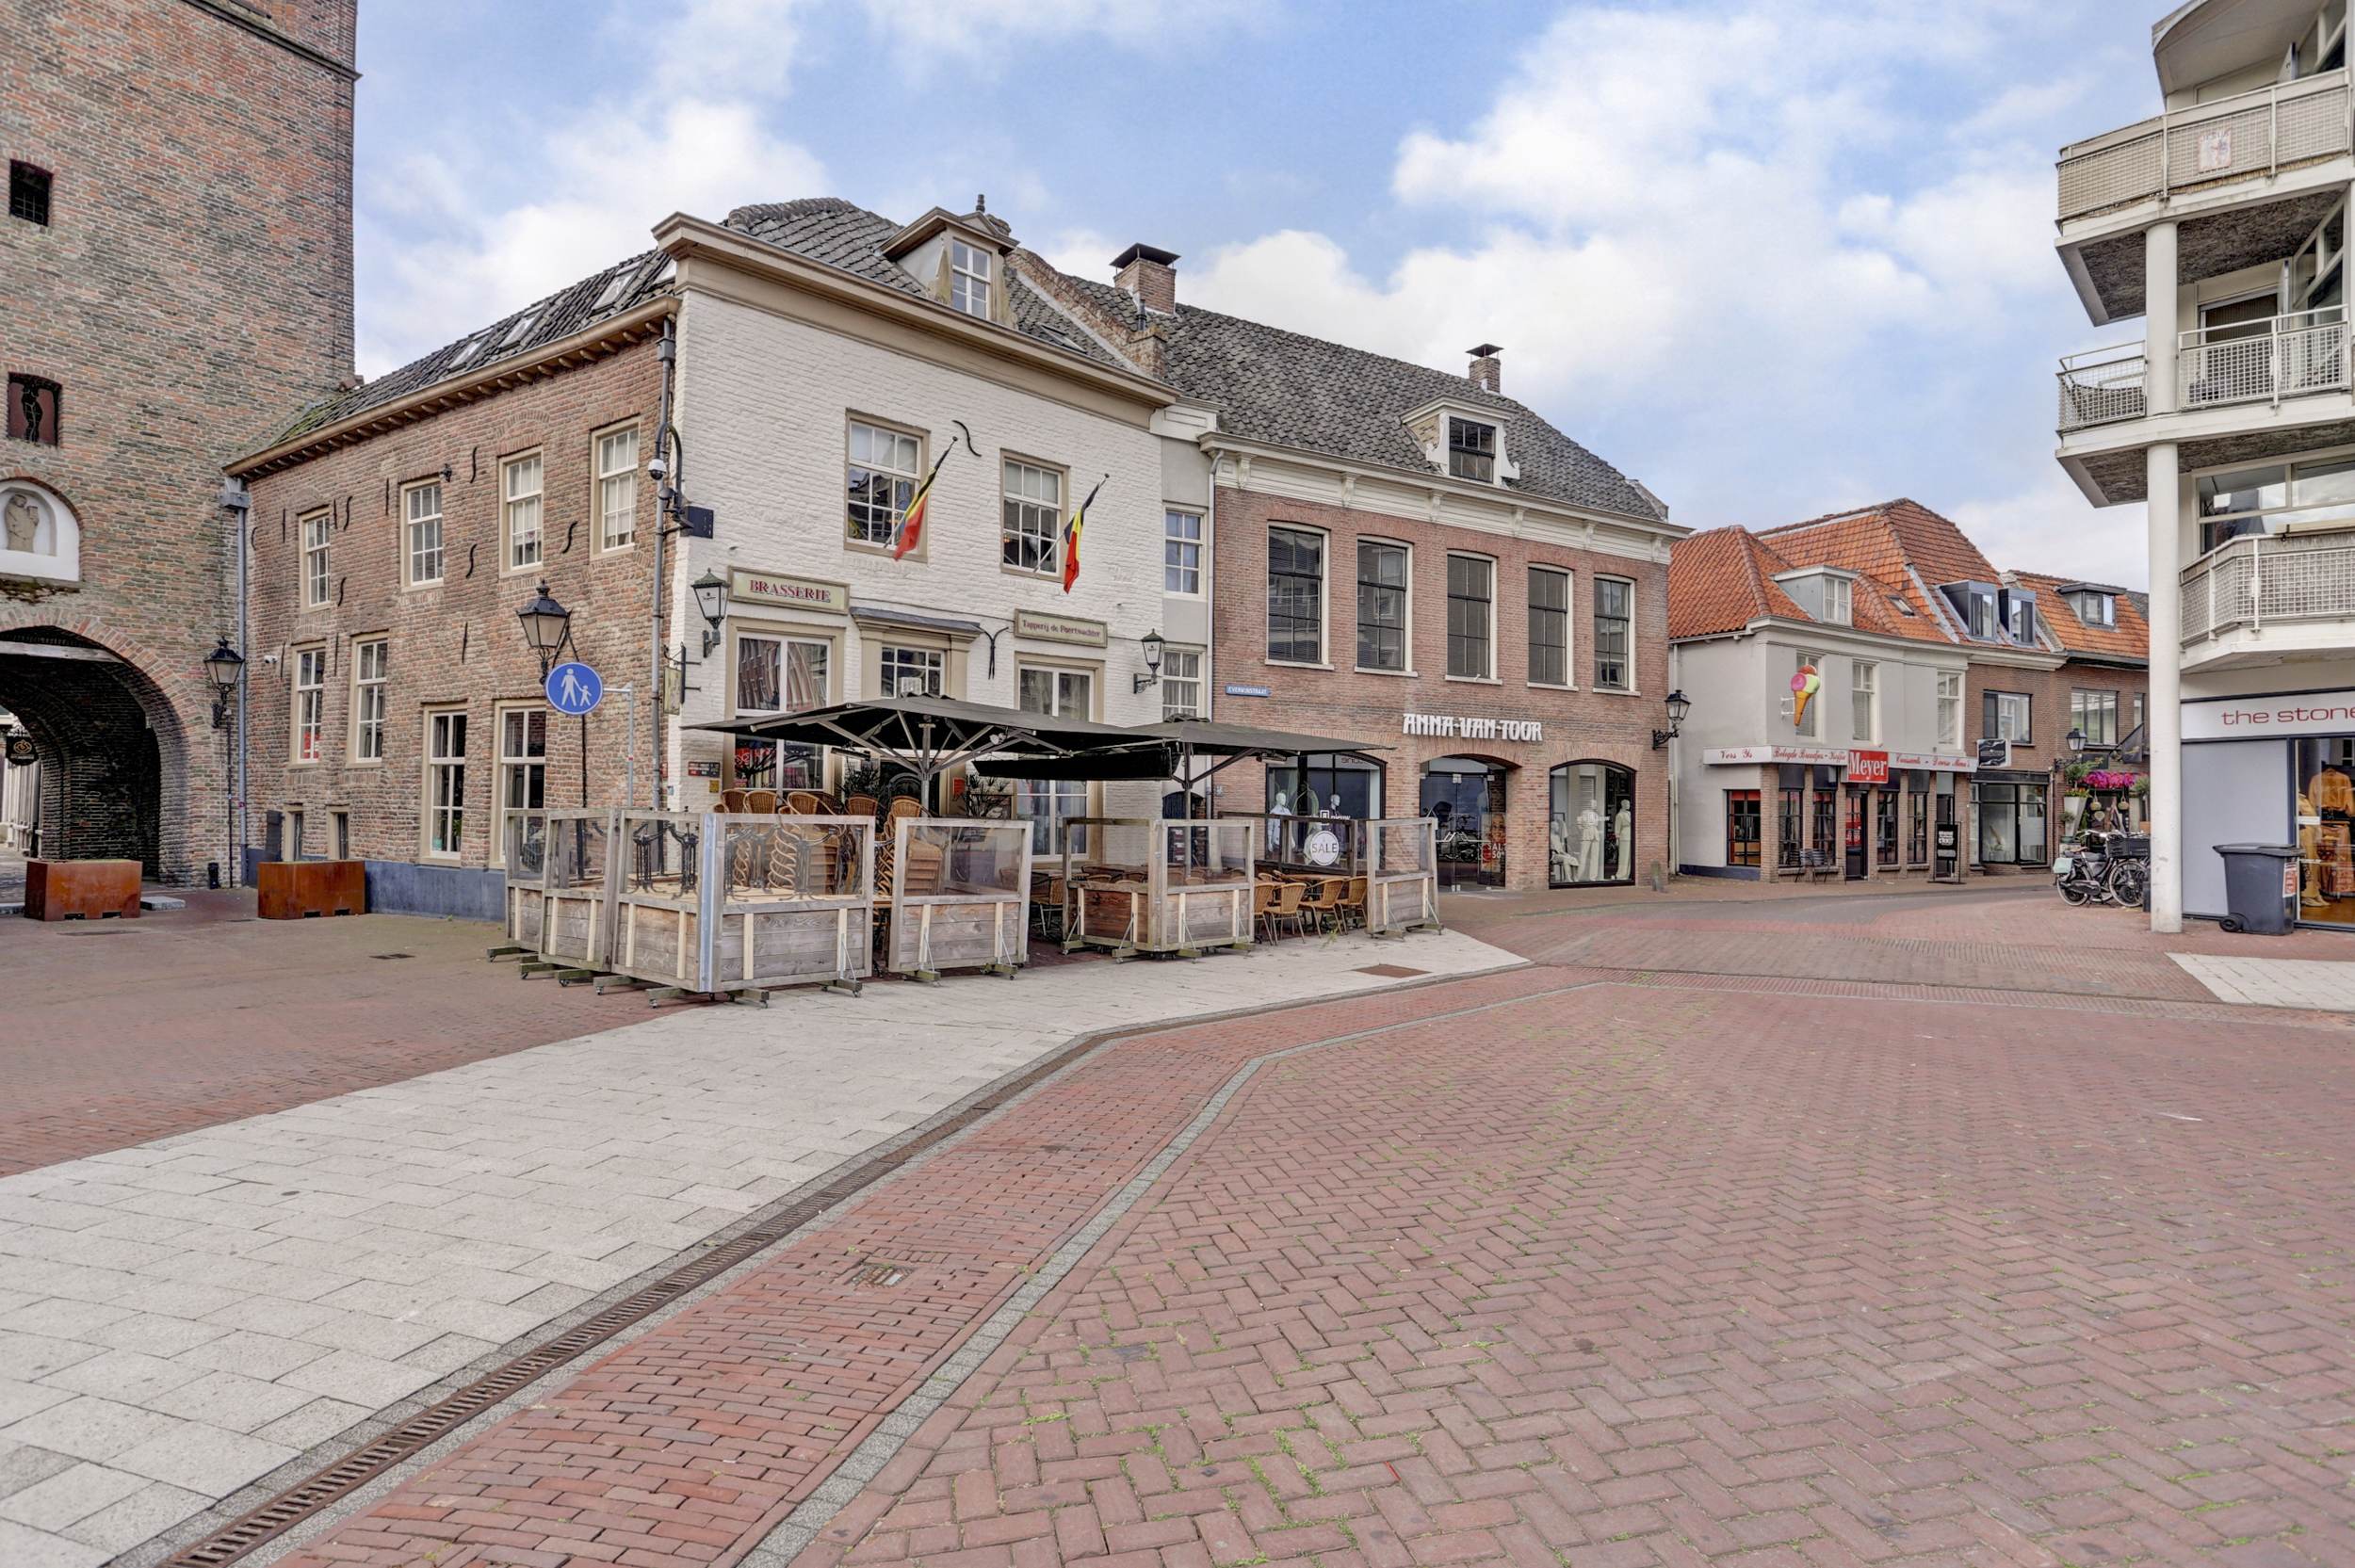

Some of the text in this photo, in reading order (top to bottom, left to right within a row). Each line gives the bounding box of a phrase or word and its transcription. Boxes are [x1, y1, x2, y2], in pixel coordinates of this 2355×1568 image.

[2200, 131, 2229, 142] JESUS
[749, 580, 831, 603] BRASSERIE
[1022, 619, 1048, 632] Tapperij
[2221, 710, 2269, 725] the
[1403, 713, 1543, 741] ANNA VAN TOOR
[1720, 749, 1736, 759] Vers
[1773, 747, 1797, 762] Belegde
[1849, 752, 1887, 780] Meyer
[1311, 843, 1338, 853] SALE
